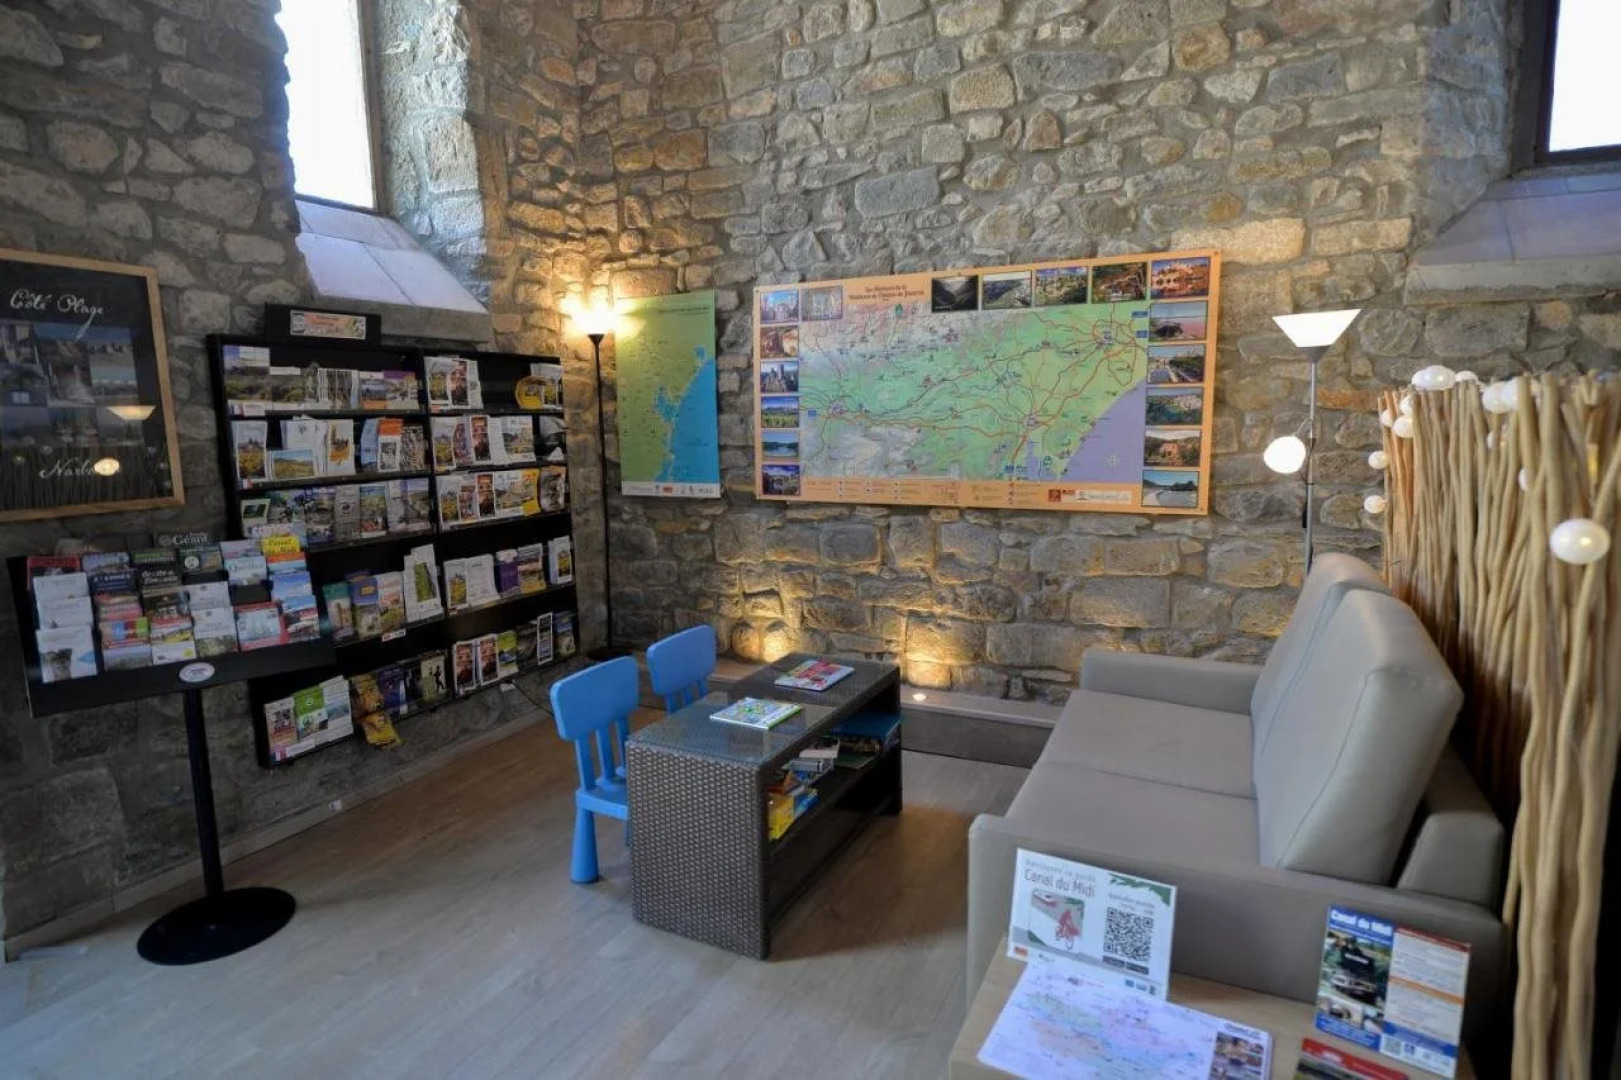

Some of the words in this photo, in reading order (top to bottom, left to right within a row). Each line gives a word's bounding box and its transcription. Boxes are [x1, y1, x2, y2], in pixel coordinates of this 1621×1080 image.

[56, 294, 105, 341] Plage
[1025, 869, 1054, 888] Canal
[1056, 878, 1070, 891] du
[1073, 880, 1095, 898] Midi
